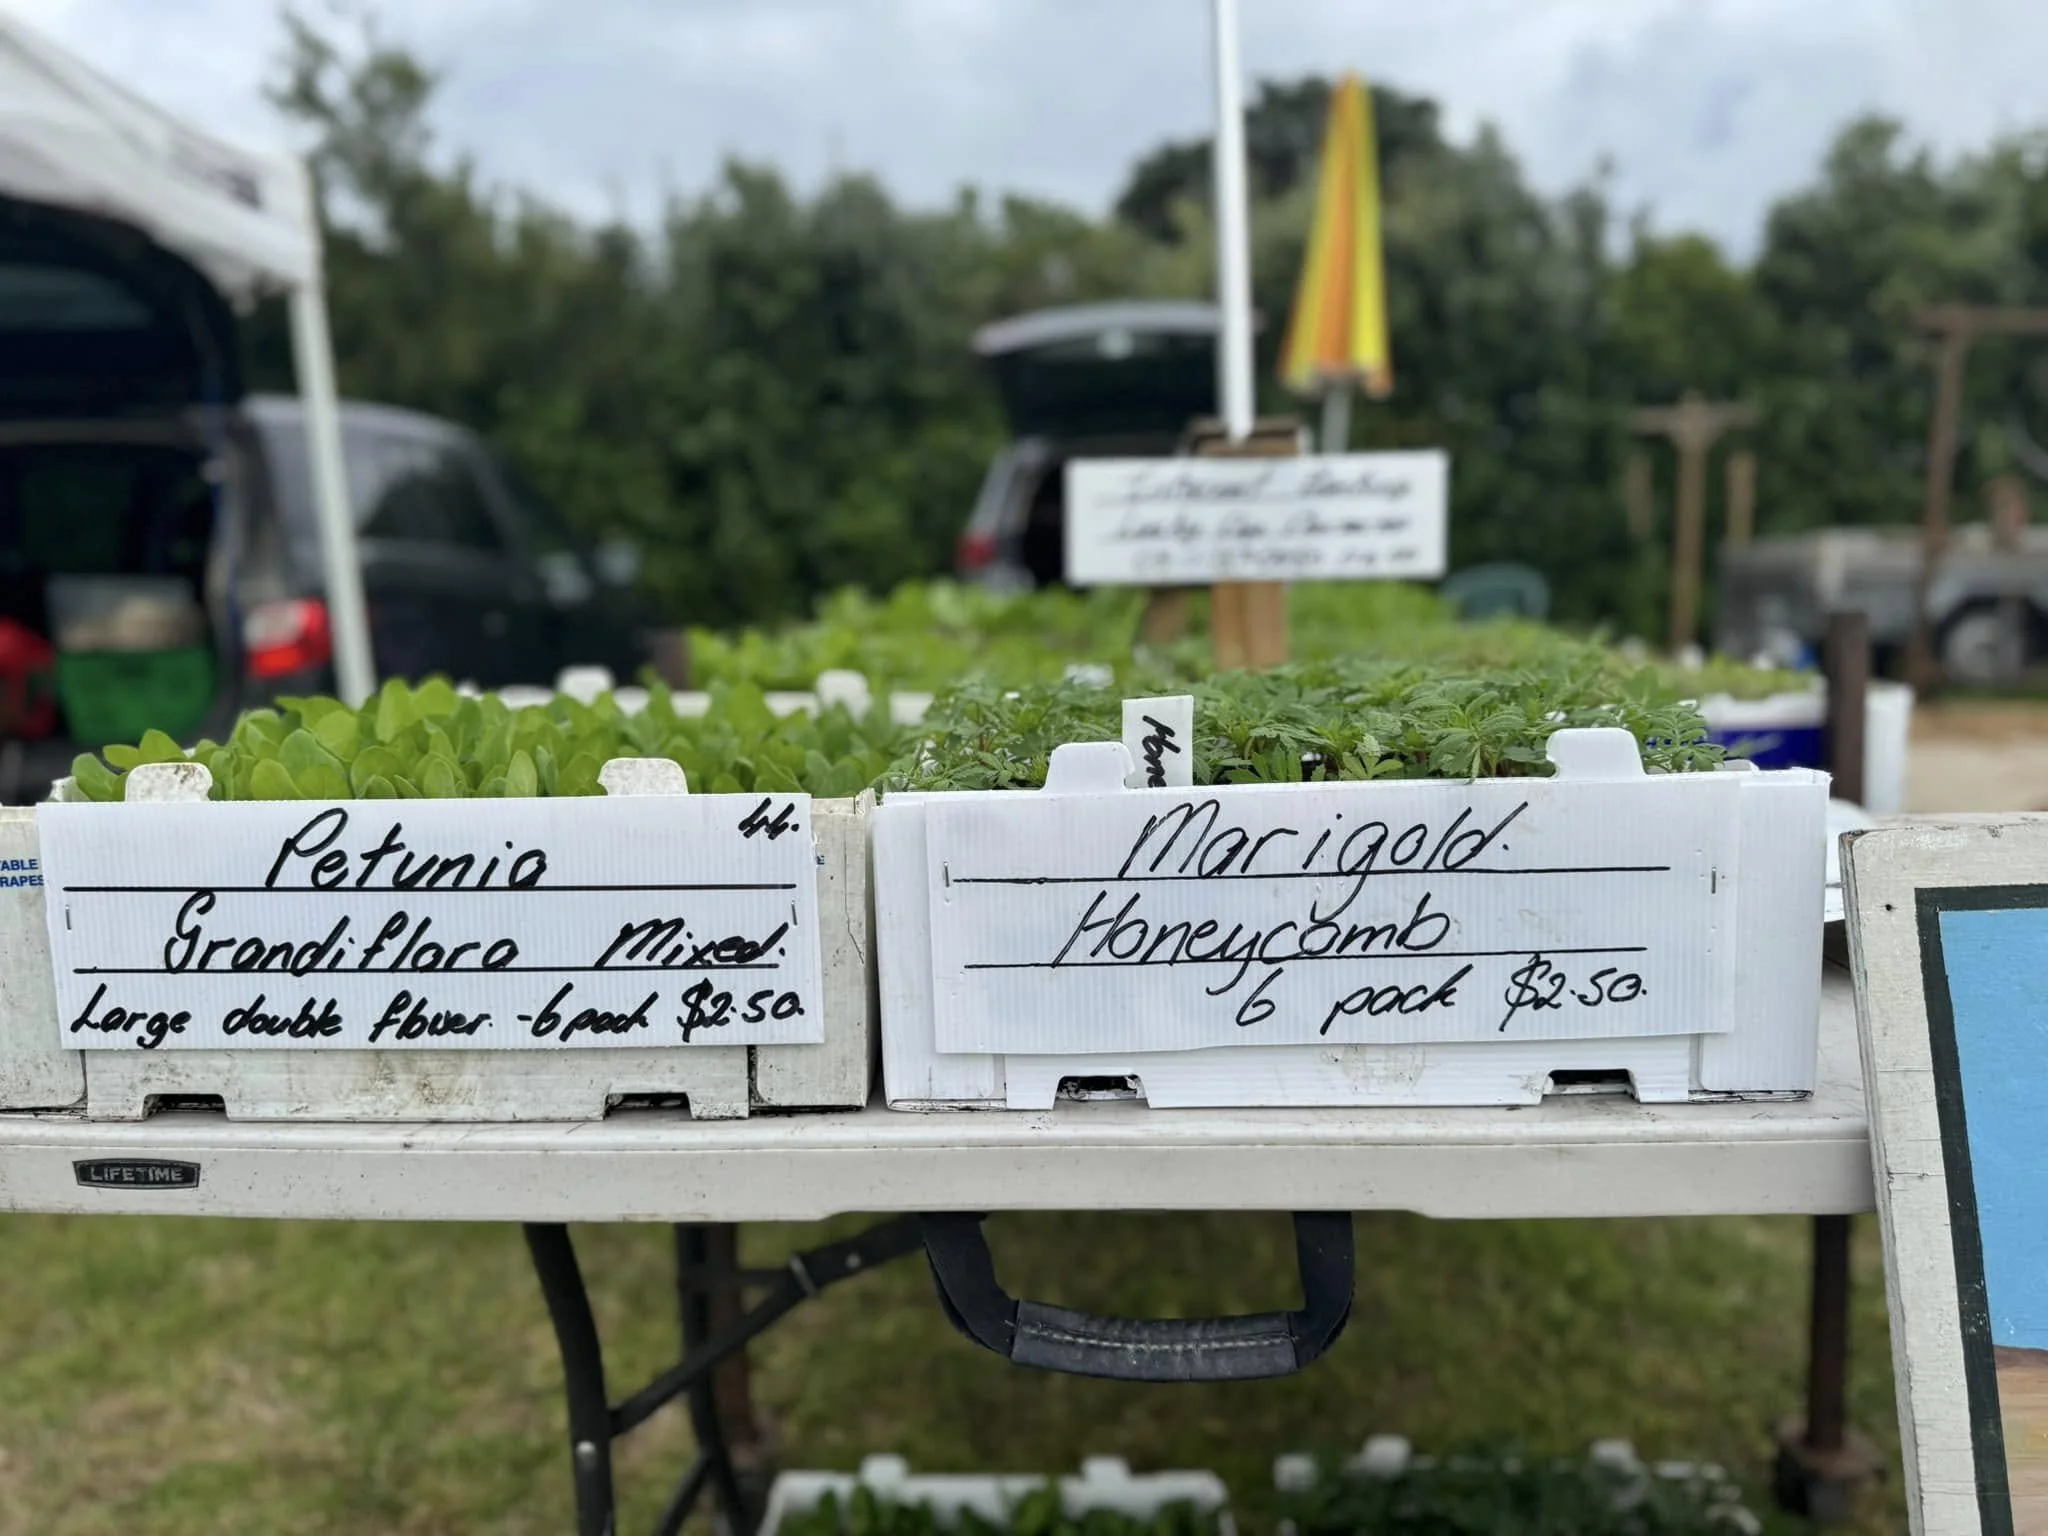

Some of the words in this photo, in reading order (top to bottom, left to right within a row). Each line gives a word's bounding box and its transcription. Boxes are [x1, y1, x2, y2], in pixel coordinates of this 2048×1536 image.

[0, 858, 39, 871] ABLE
[265, 808, 547, 889] Petunia
[1118, 799, 1528, 922] Marigold.
[164, 890, 519, 977] Grandiflora
[594, 916, 789, 968] Mixed.
[1051, 890, 1451, 996] Honeycomb
[70, 983, 192, 1049] Large
[222, 993, 343, 1039] double
[1235, 967, 1284, 1026] 6
[1320, 964, 1473, 1034] pack
[89, 1166, 185, 1182] LIFETIME
